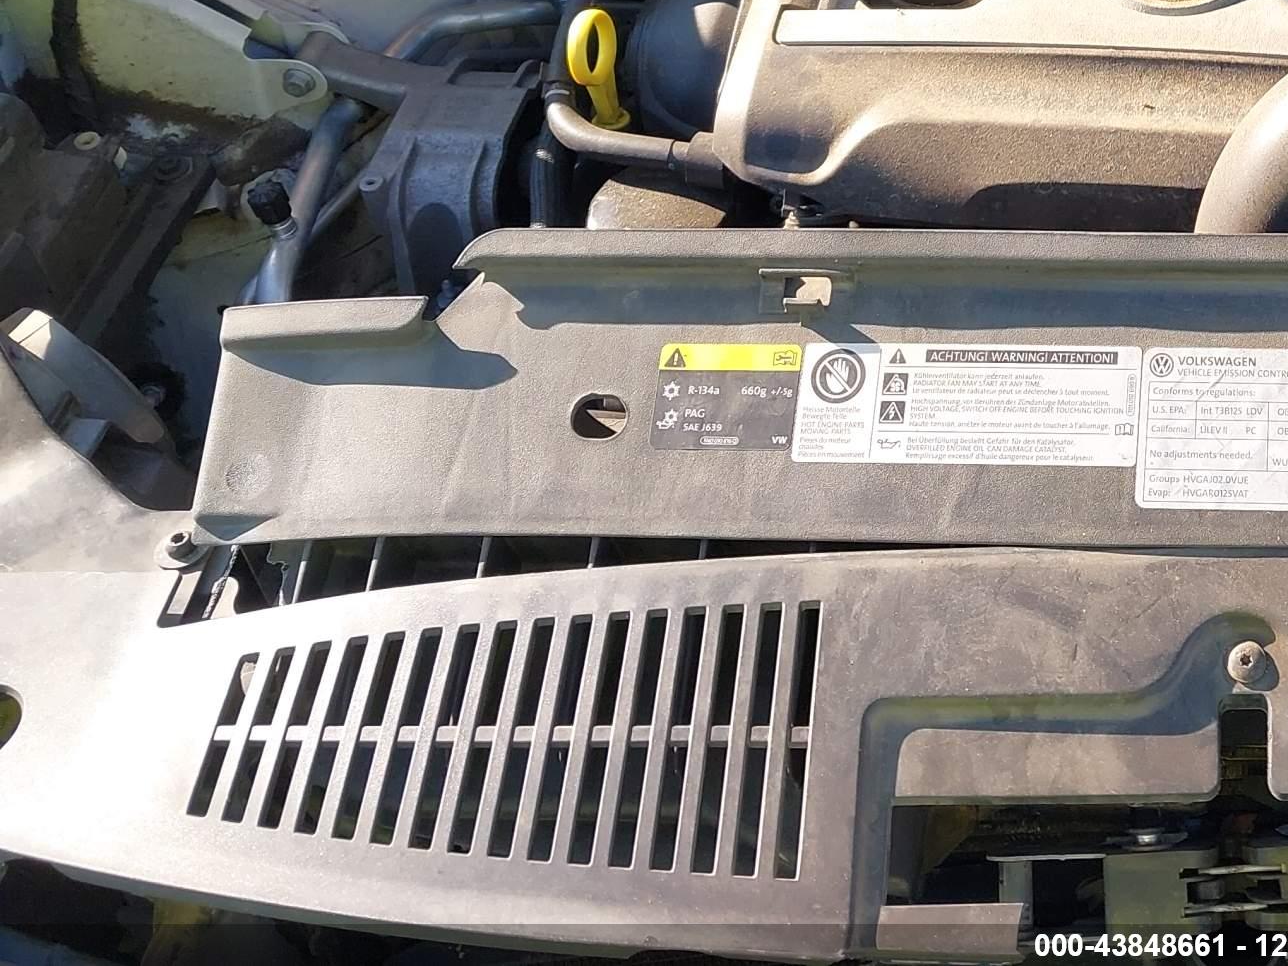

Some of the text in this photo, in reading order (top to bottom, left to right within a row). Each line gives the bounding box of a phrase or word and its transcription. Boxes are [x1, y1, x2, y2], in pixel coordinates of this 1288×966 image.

[1178, 355, 1257, 367] VOLKSWAGEN
[1177, 368, 1213, 377] VEHICLE
[1214, 368, 1255, 378] EMISSION
[687, 385, 720, 395] R-134a
[741, 386, 767, 398] 660g
[1152, 386, 1256, 399] Conforms to regulations:
[684, 408, 705, 418] PAG
[1246, 407, 1263, 415] LDV
[682, 423, 722, 432] SAE J639
[1245, 426, 1257, 435] PC
[771, 435, 788, 445] VW
[1149, 450, 1162, 458] No
[1164, 450, 1217, 460] adjustments
